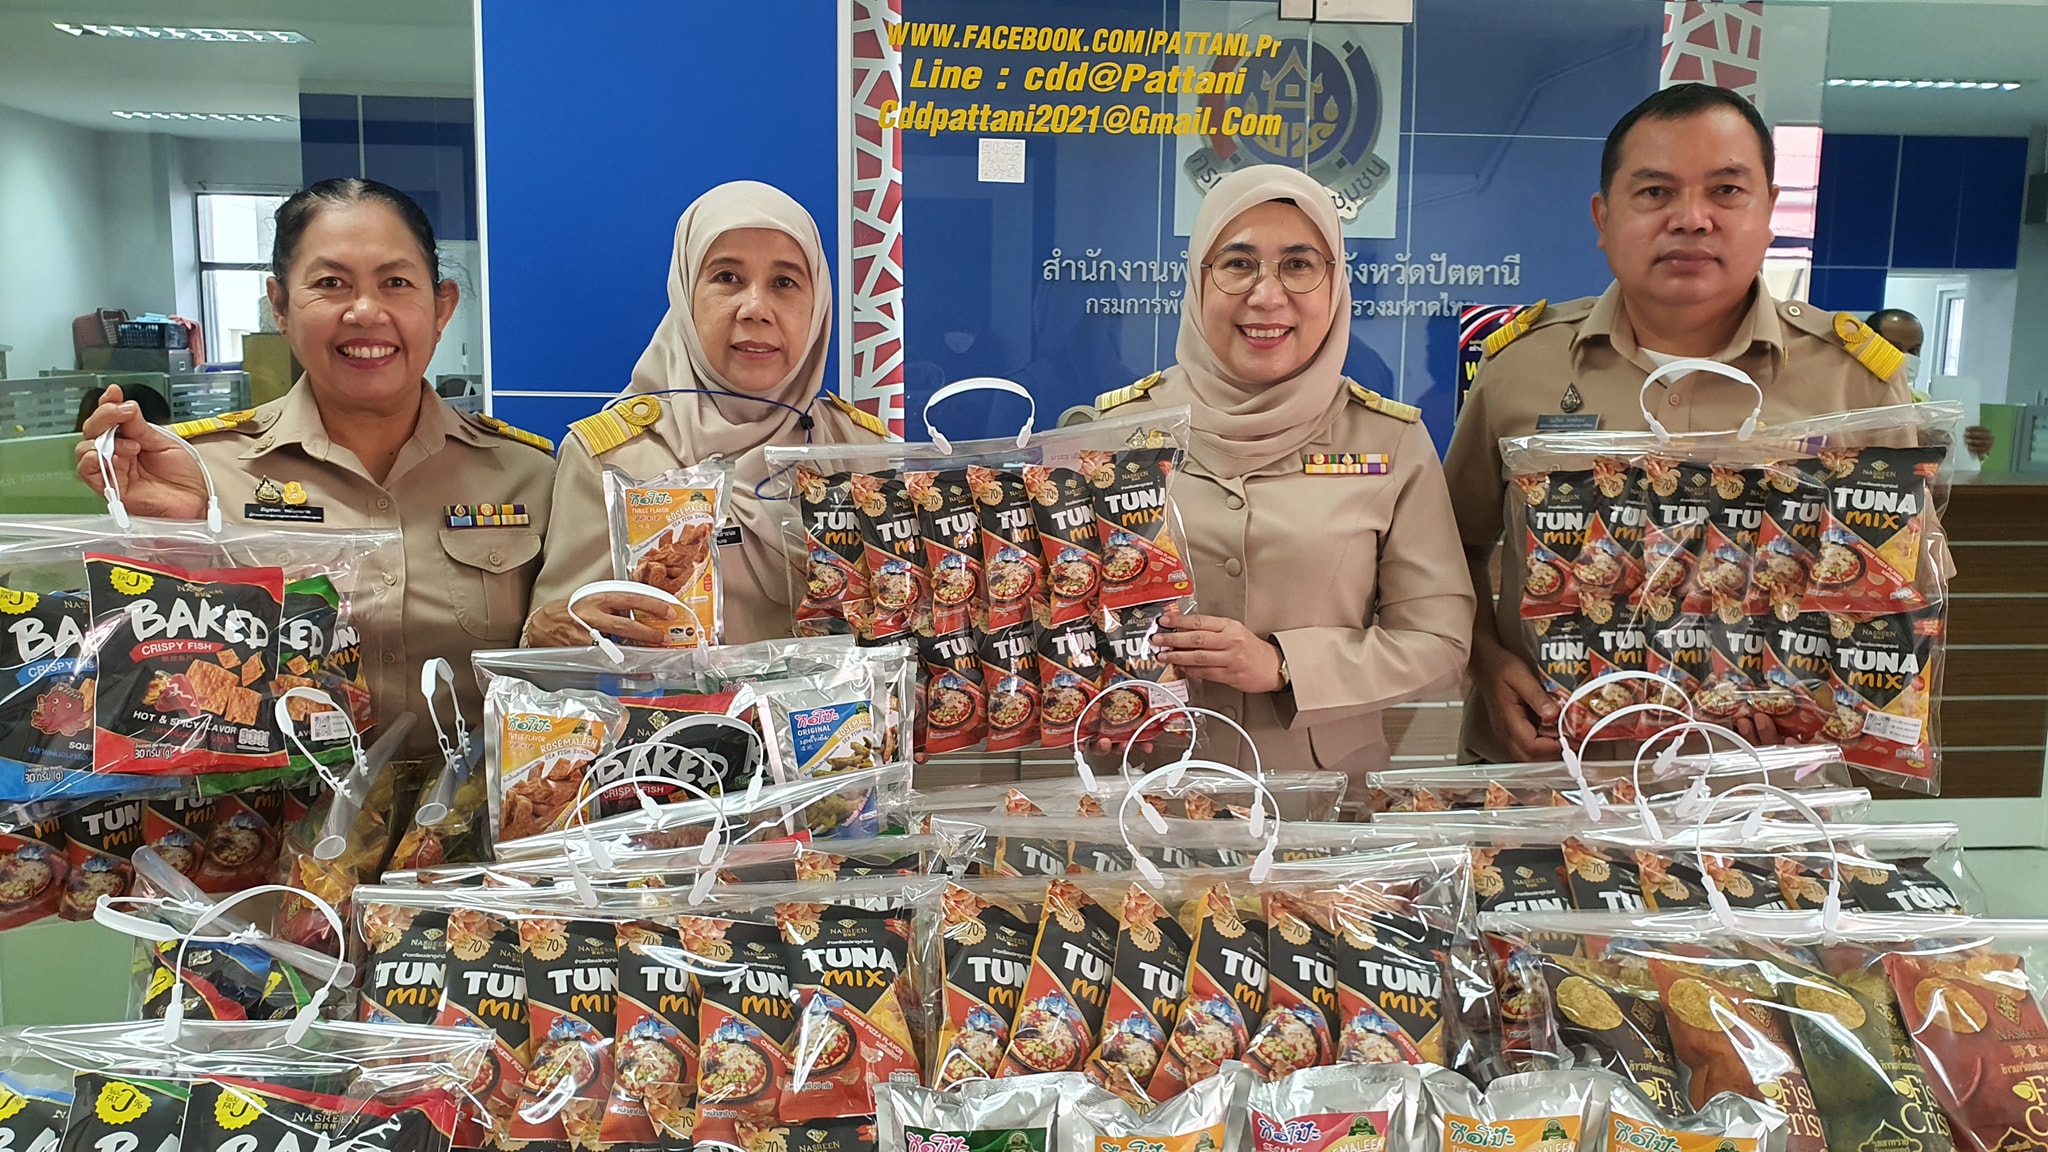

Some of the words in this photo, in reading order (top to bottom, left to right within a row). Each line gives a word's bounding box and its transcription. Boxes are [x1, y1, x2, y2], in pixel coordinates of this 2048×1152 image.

[910, 58, 983, 89] Line
[997, 67, 1010, 90] :
[1023, 60, 1246, 94] cdd@Pattani
[877, 99, 1282, 137] Cddpattani2021@Gmail.Com
[1085, 290, 1184, 315] กรมการพั
[1352, 292, 1477, 317] รวงมหาดไท
[1782, 500, 1822, 522] TU
[1833, 487, 1918, 515] TUNA
[1070, 523, 1097, 542] MI
[124, 598, 269, 649] BAKED
[8, 615, 94, 663] BA
[141, 641, 184, 656] CRISPY
[187, 641, 212, 651] FISH
[281, 619, 324, 657] ED
[1836, 647, 1920, 674] TUNA
[133, 710, 156, 722] HOT
[159, 714, 168, 725] &
[170, 717, 201, 730] SPICY
[797, 725, 831, 736] ORIGINAL
[525, 734, 546, 742] FLAVOR
[540, 735, 598, 753] ROSEMALEEN
[134, 749, 146, 759] 30
[545, 753, 556, 761] SEA
[590, 744, 729, 788] BAKED
[24, 773, 36, 784] 30
[602, 787, 637, 799] CRISPY
[641, 786, 664, 794] FISH
[1598, 891, 1646, 913] TU
[830, 927, 868, 935] NASREEN
[802, 947, 899, 976] TUNA
[1292, 955, 1335, 989] TU
[1138, 961, 1184, 999] TU
[571, 992, 617, 1013] MI
[843, 1009, 866, 1029] CHEESE
[865, 1024, 882, 1041] PIZZA
[879, 1036, 904, 1056] FLAVOR
[676, 1038, 697, 1060] CHEESE
[759, 1039, 781, 1058] CHEESE
[104, 1095, 119, 1105] FAT
[222, 1101, 236, 1111] FAT
[292, 1111, 361, 1125] NASREEN
[1777, 1107, 1826, 1147] ris
[799, 1140, 841, 1152] NASREEN
